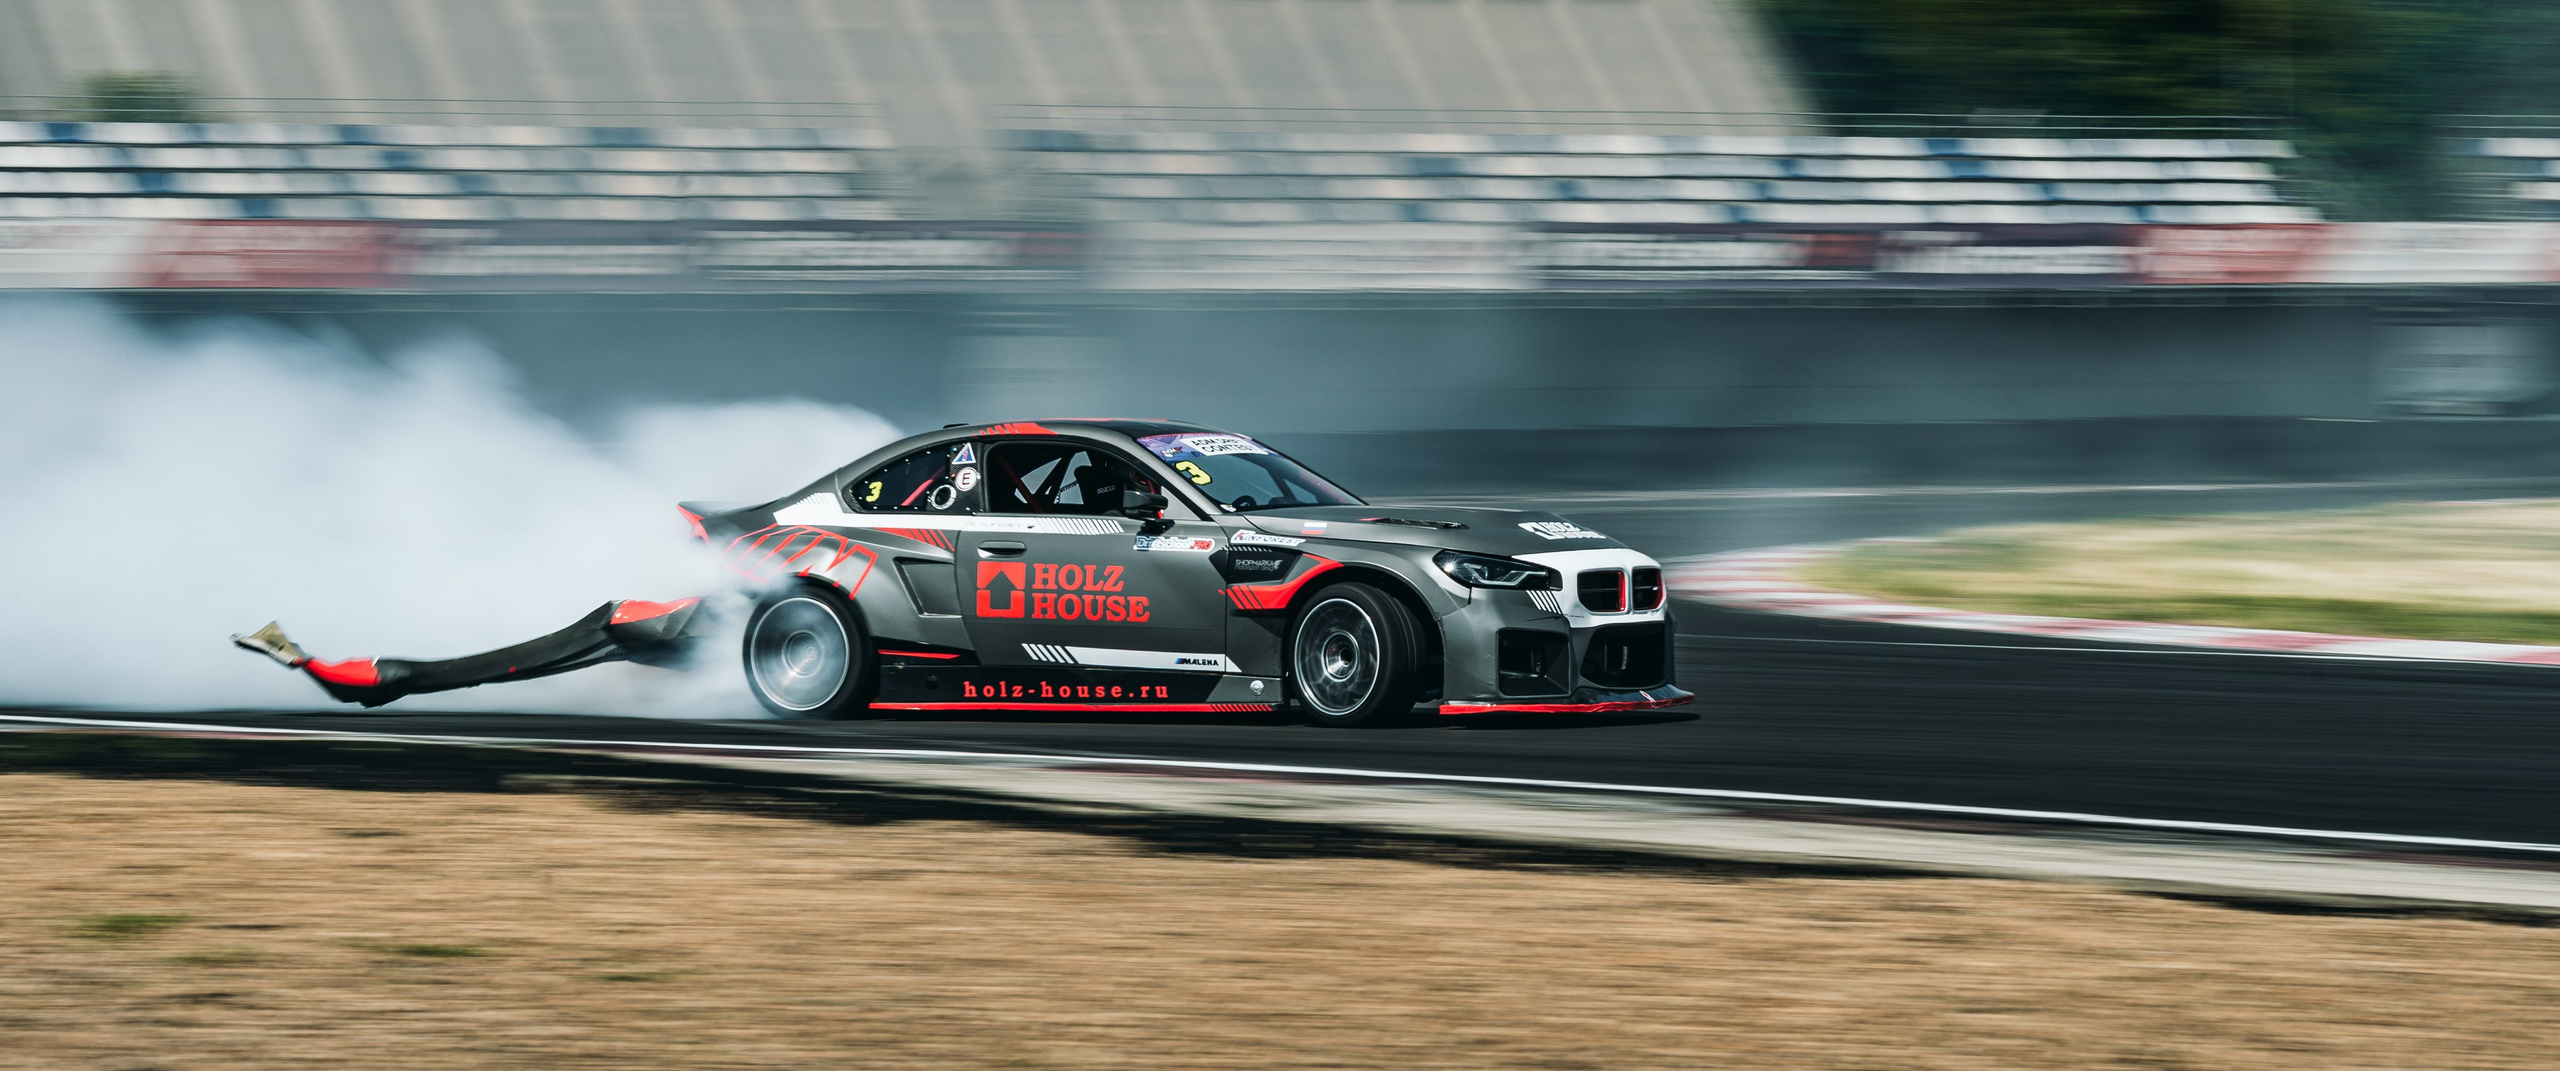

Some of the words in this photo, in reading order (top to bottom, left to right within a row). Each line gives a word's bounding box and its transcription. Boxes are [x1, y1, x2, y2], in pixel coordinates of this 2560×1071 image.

[961, 472, 971, 486] E
[1175, 460, 1213, 486] 3
[865, 481, 883, 503] 3
[1235, 559, 1275, 568] SHOPMARKA
[1031, 563, 1125, 592] HOLZ
[1031, 593, 1150, 623] HOUSE
[1182, 658, 1219, 667] MALENA
[963, 681, 1169, 698] holz-house.ru
